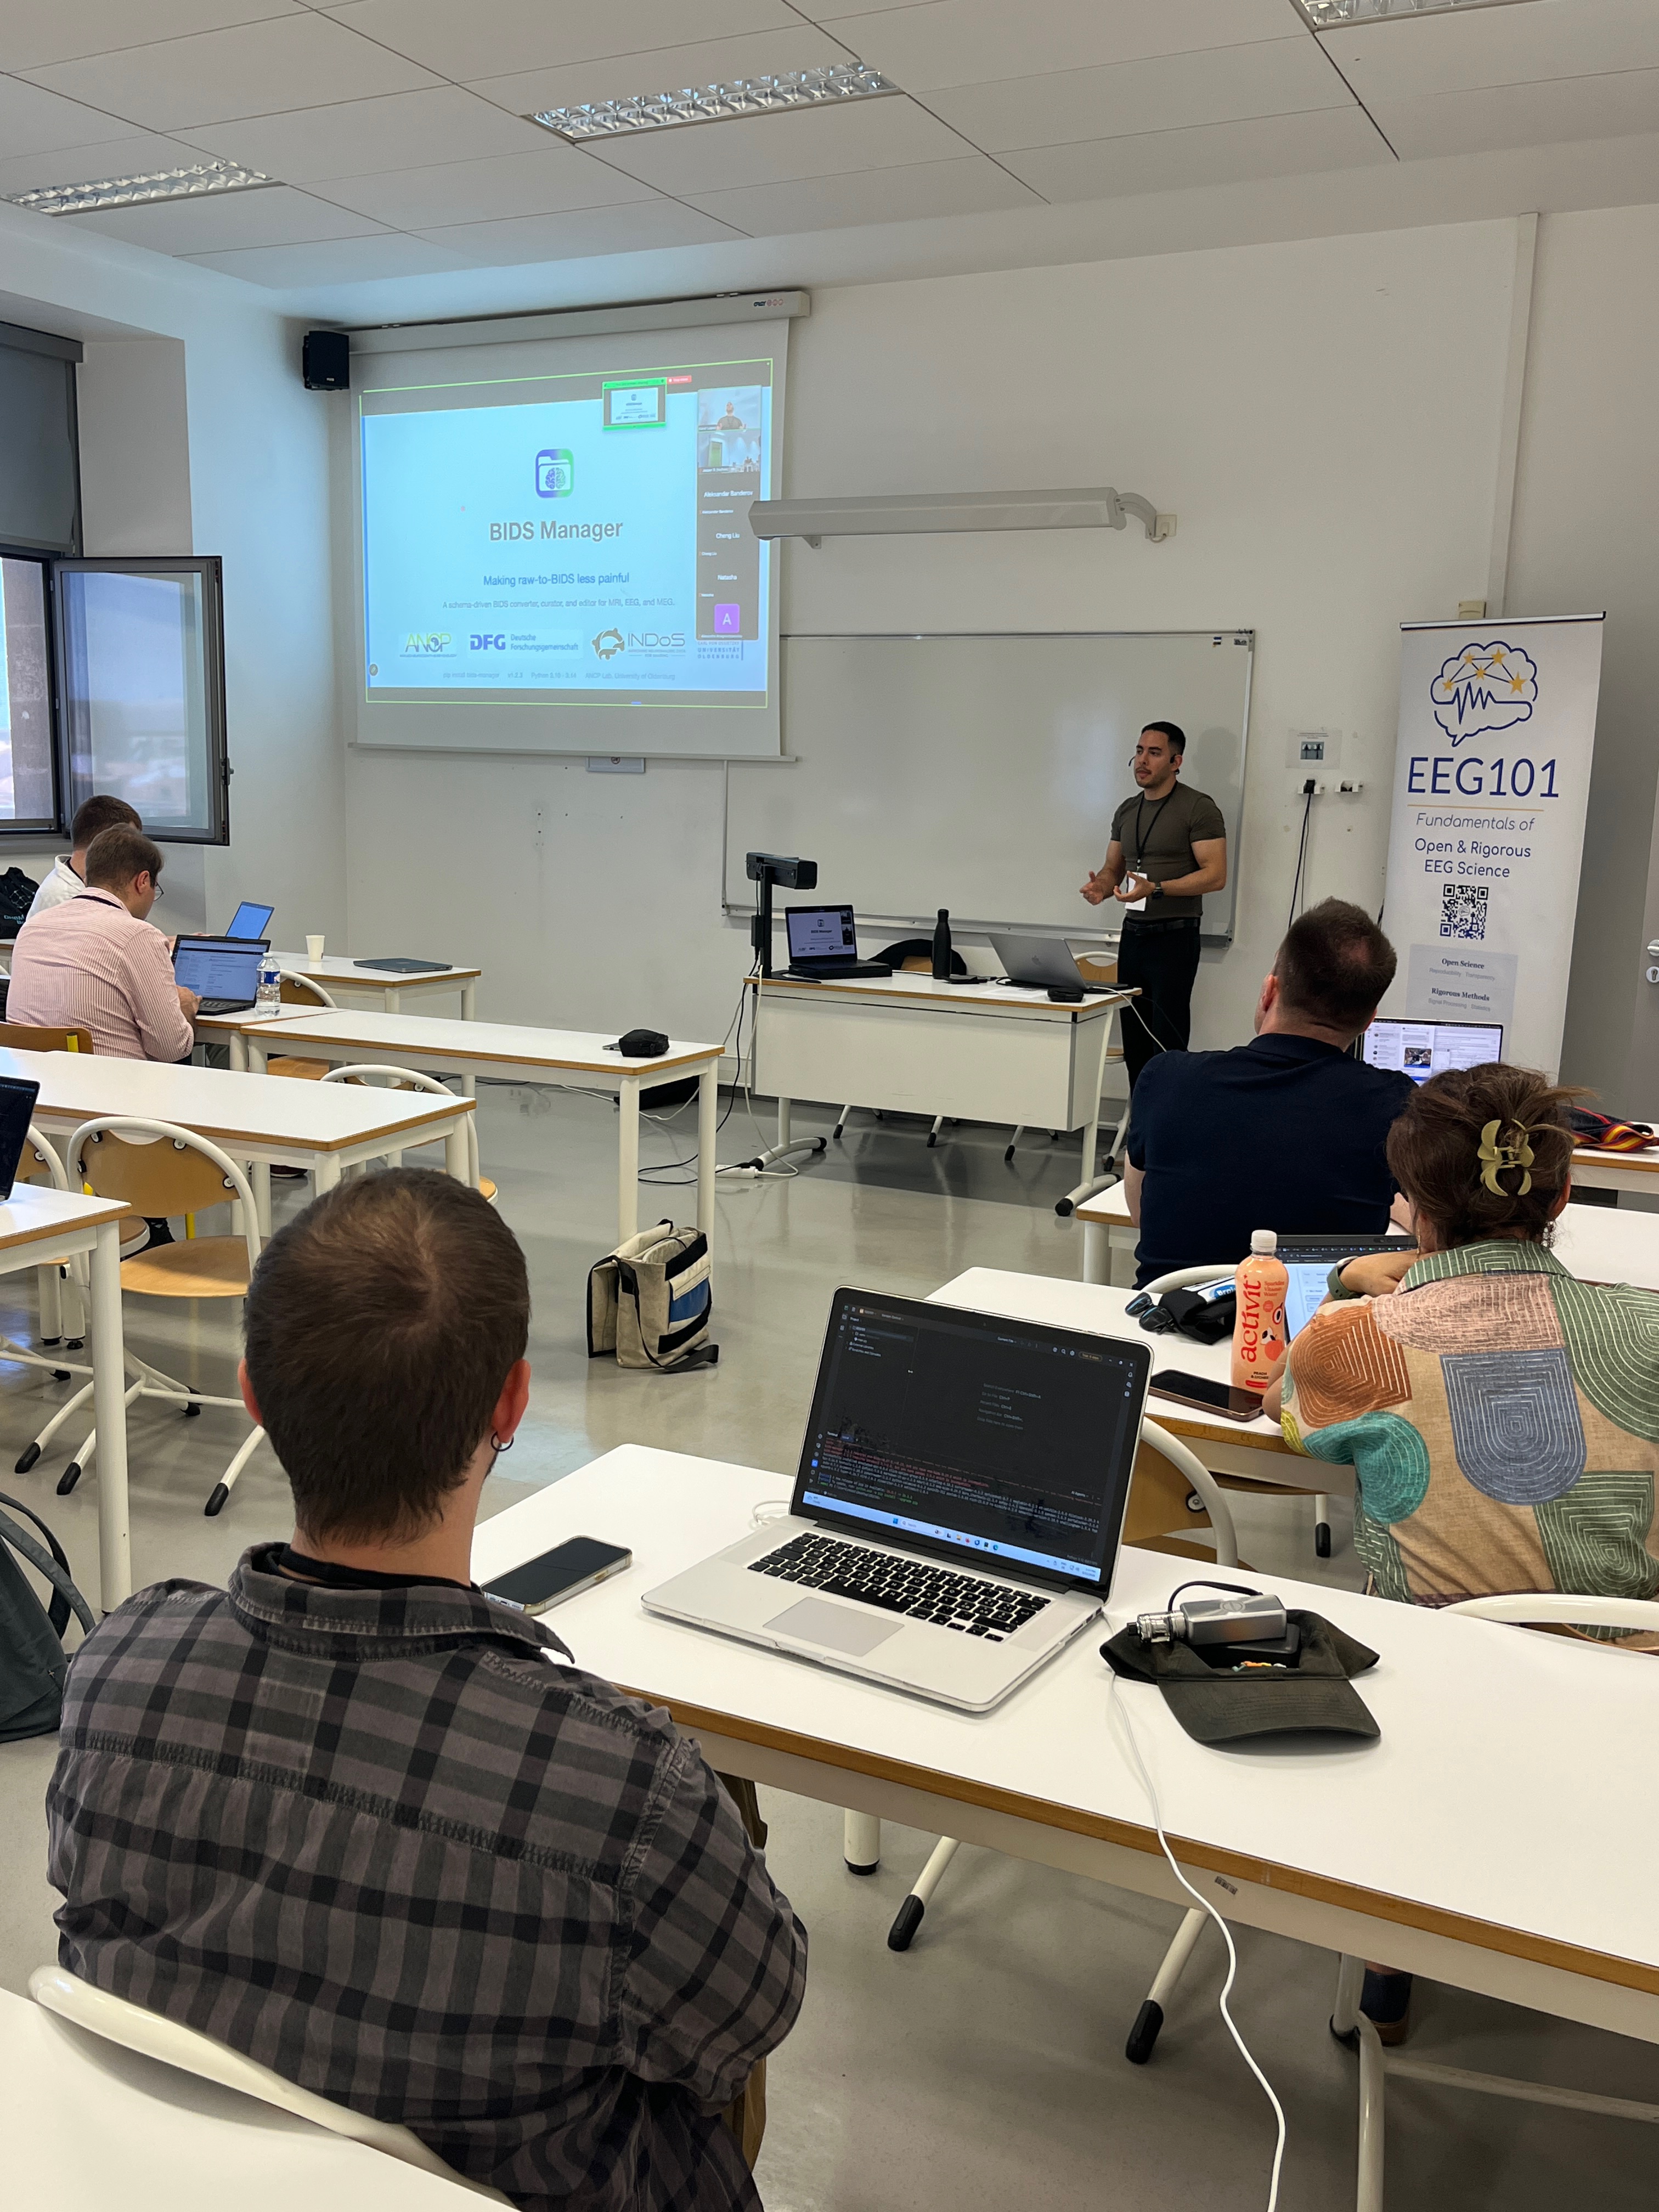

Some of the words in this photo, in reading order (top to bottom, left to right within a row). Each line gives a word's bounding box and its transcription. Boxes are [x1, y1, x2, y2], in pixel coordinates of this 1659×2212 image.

[490, 522, 534, 541] BIDS
[540, 521, 623, 542] Manager
[483, 575, 516, 587] Making
[518, 574, 574, 585] raw-to-BIDS
[577, 573, 595, 584] less
[598, 572, 629, 585] painful
[642, 598, 654, 606] and
[723, 613, 732, 625] A
[470, 634, 506, 650] DFG
[510, 642, 578, 652] Forschungsgemeinschaft
[628, 633, 685, 647] INDoS
[1407, 757, 1559, 798] EEG101
[1416, 812, 1515, 831] Fundamentals
[1519, 817, 1536, 831] of
[1415, 838, 1453, 854] Open
[1457, 840, 1466, 854] &
[1470, 841, 1531, 858] Rigorous
[1424, 859, 1453, 873] EEG
[1457, 861, 1510, 878] Science
[1460, 960, 1485, 969] Science
[1431, 988, 1460, 997] Rigorous
[1461, 991, 1489, 1001] Methods
